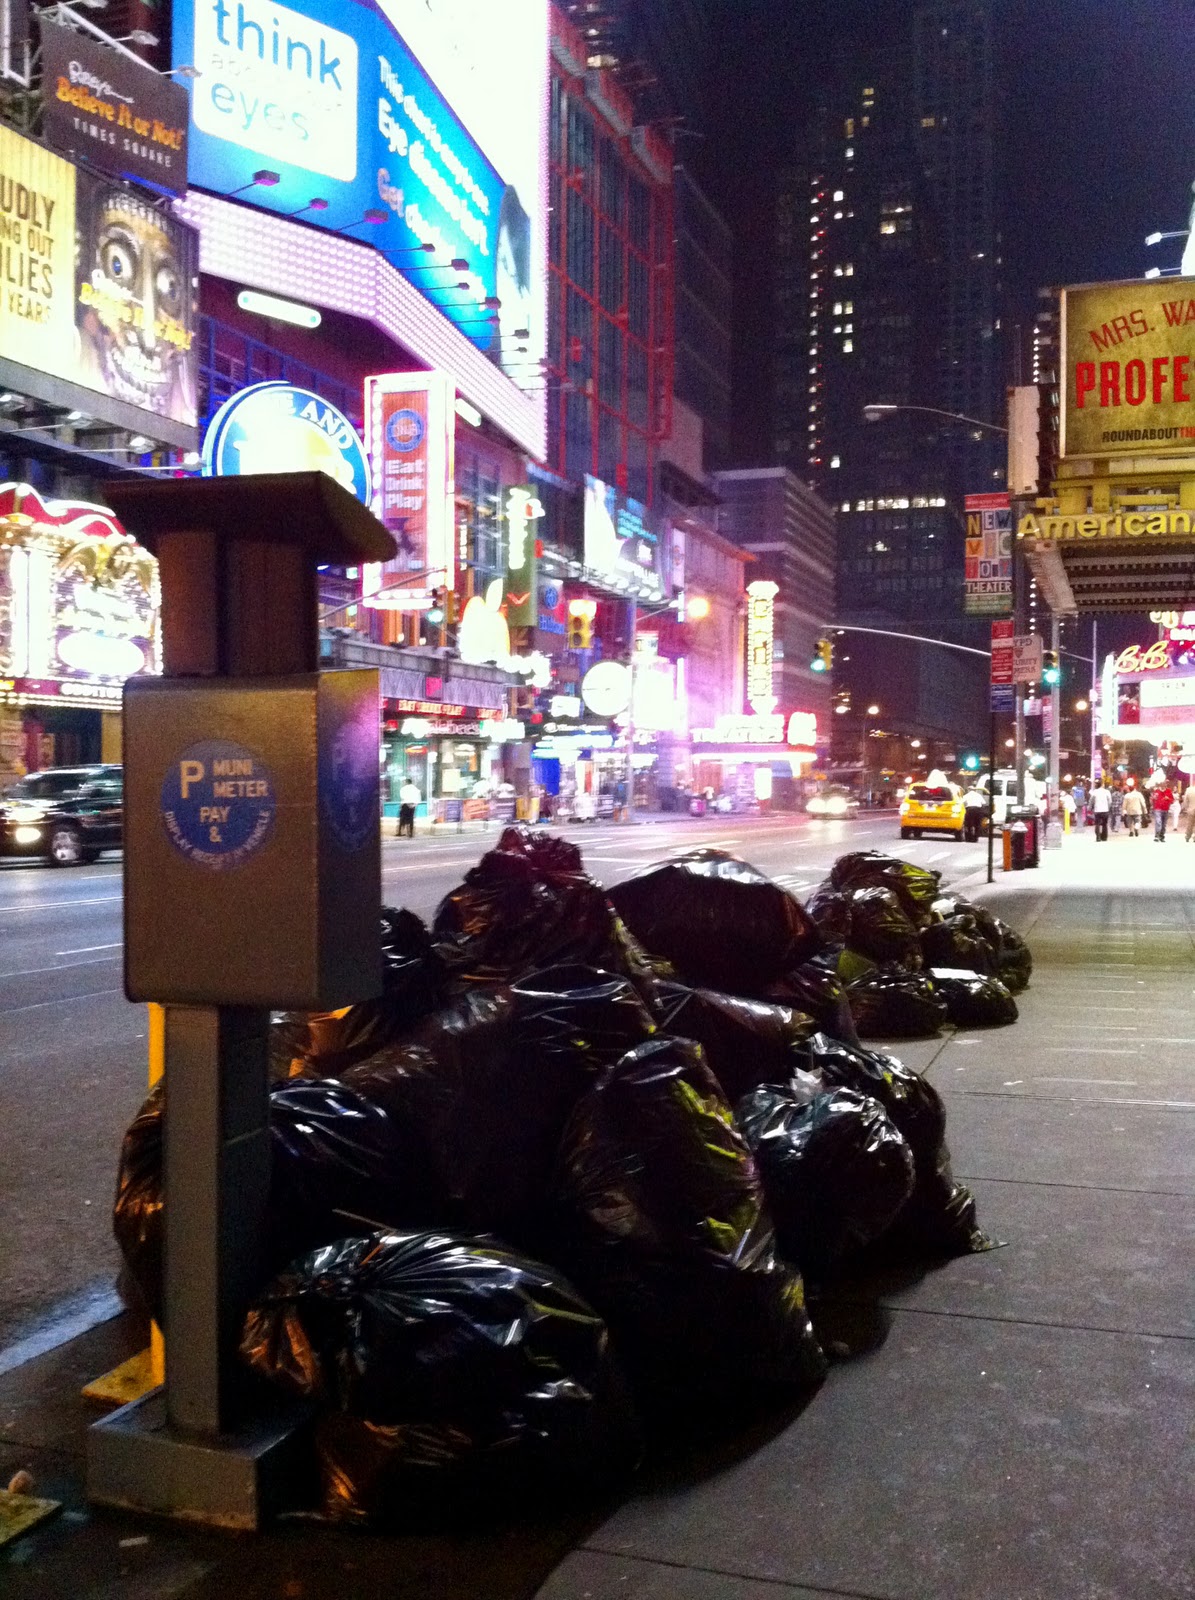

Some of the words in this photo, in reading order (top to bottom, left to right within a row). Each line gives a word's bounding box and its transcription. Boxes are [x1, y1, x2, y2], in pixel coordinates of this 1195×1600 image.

[212, 0, 342, 92] think
[211, 82, 309, 141] eyes
[73, 117, 116, 145] TIMES
[123, 138, 172, 168] SQUARE
[28, 228, 54, 261] OUT
[1089, 309, 1155, 353] MRS.
[1076, 355, 1195, 409] PROFE
[1101, 427, 1179, 443] ROUNDABOUT
[385, 458, 424, 475] Eat
[385, 477, 424, 492] Drink
[385, 493, 424, 510] Play
[967, 509, 1012, 536] NEW
[1016, 509, 1191, 540] American
[967, 581, 1012, 594] THEATER
[1013, 637, 1033, 647] YPD
[213, 759, 253, 776] MUNI
[179, 760, 205, 799] P
[213, 780, 269, 798] METER
[200, 806, 231, 823] PAY
[209, 826, 223, 843] &
